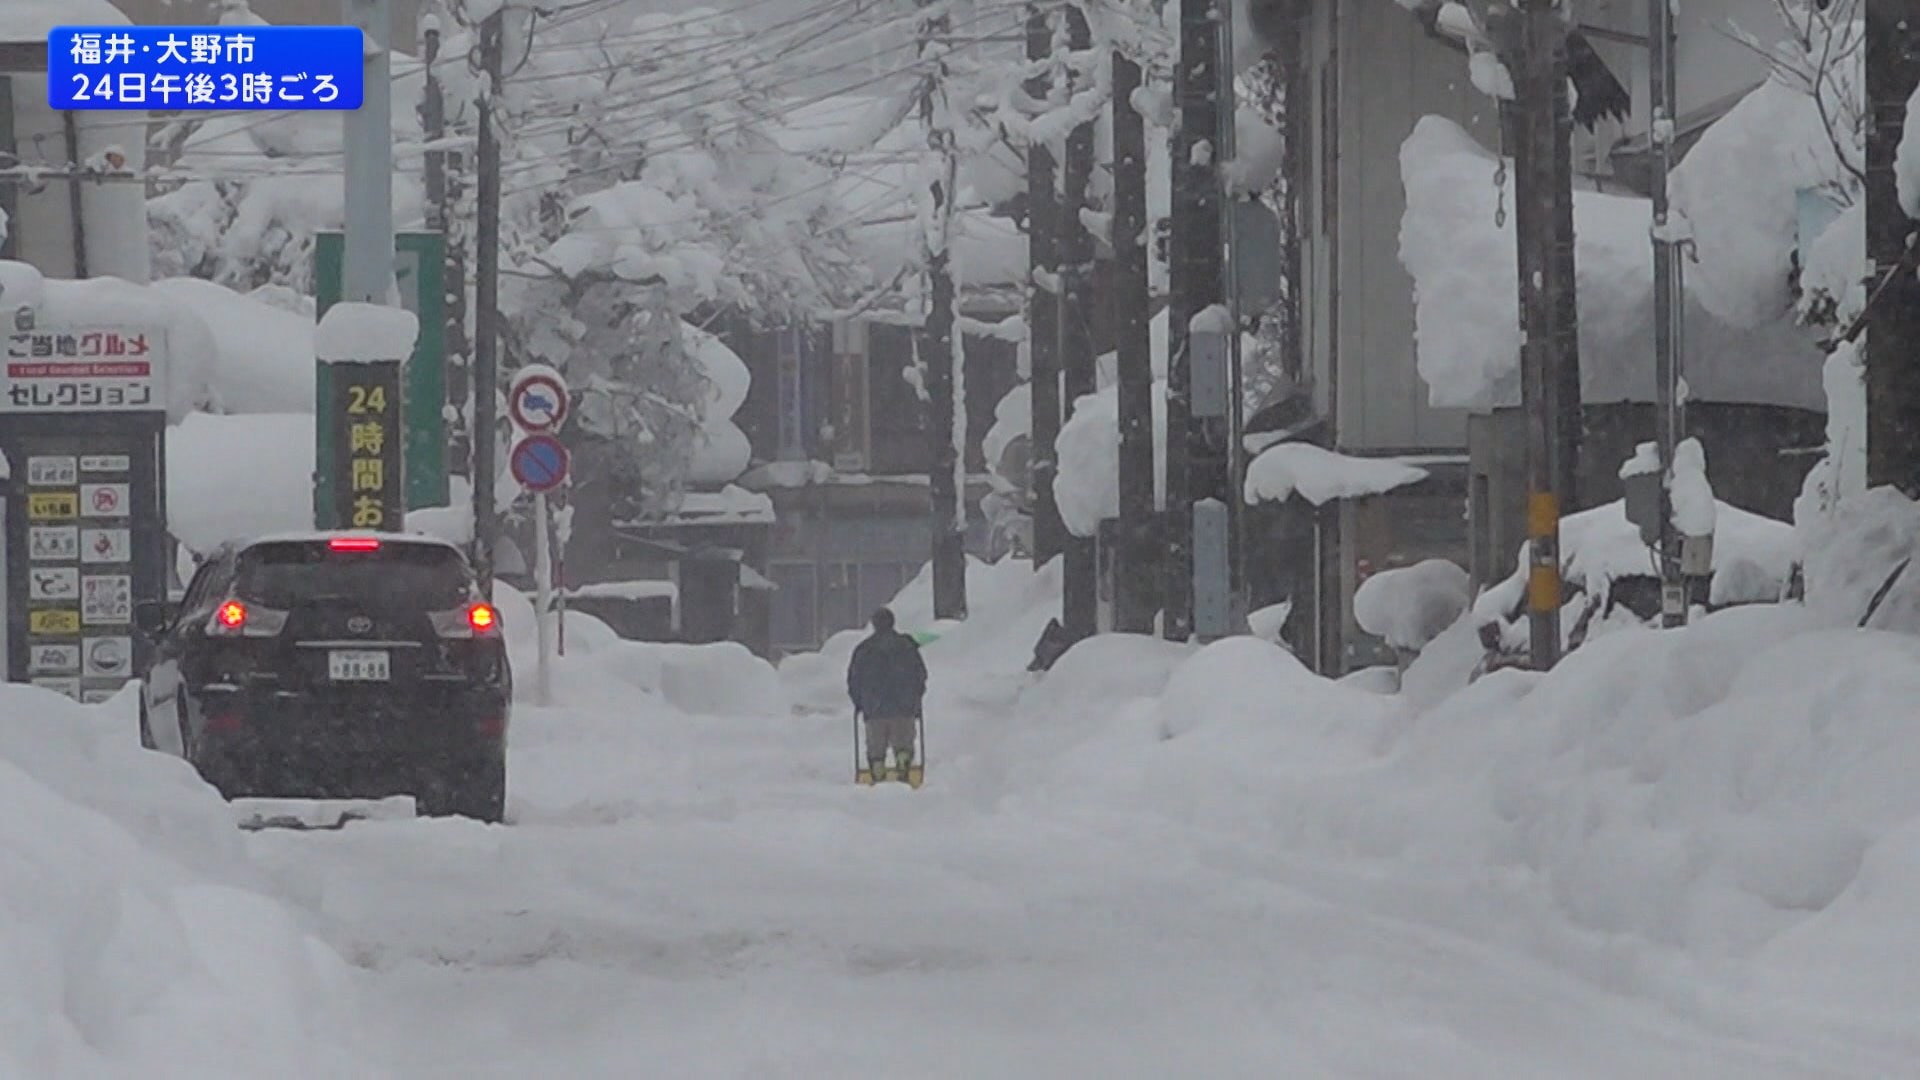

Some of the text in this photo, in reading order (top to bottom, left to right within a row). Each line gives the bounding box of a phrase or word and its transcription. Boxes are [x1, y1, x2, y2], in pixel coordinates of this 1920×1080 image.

[8, 333, 149, 357] ご当地グルメ
[8, 384, 149, 405] セレクション
